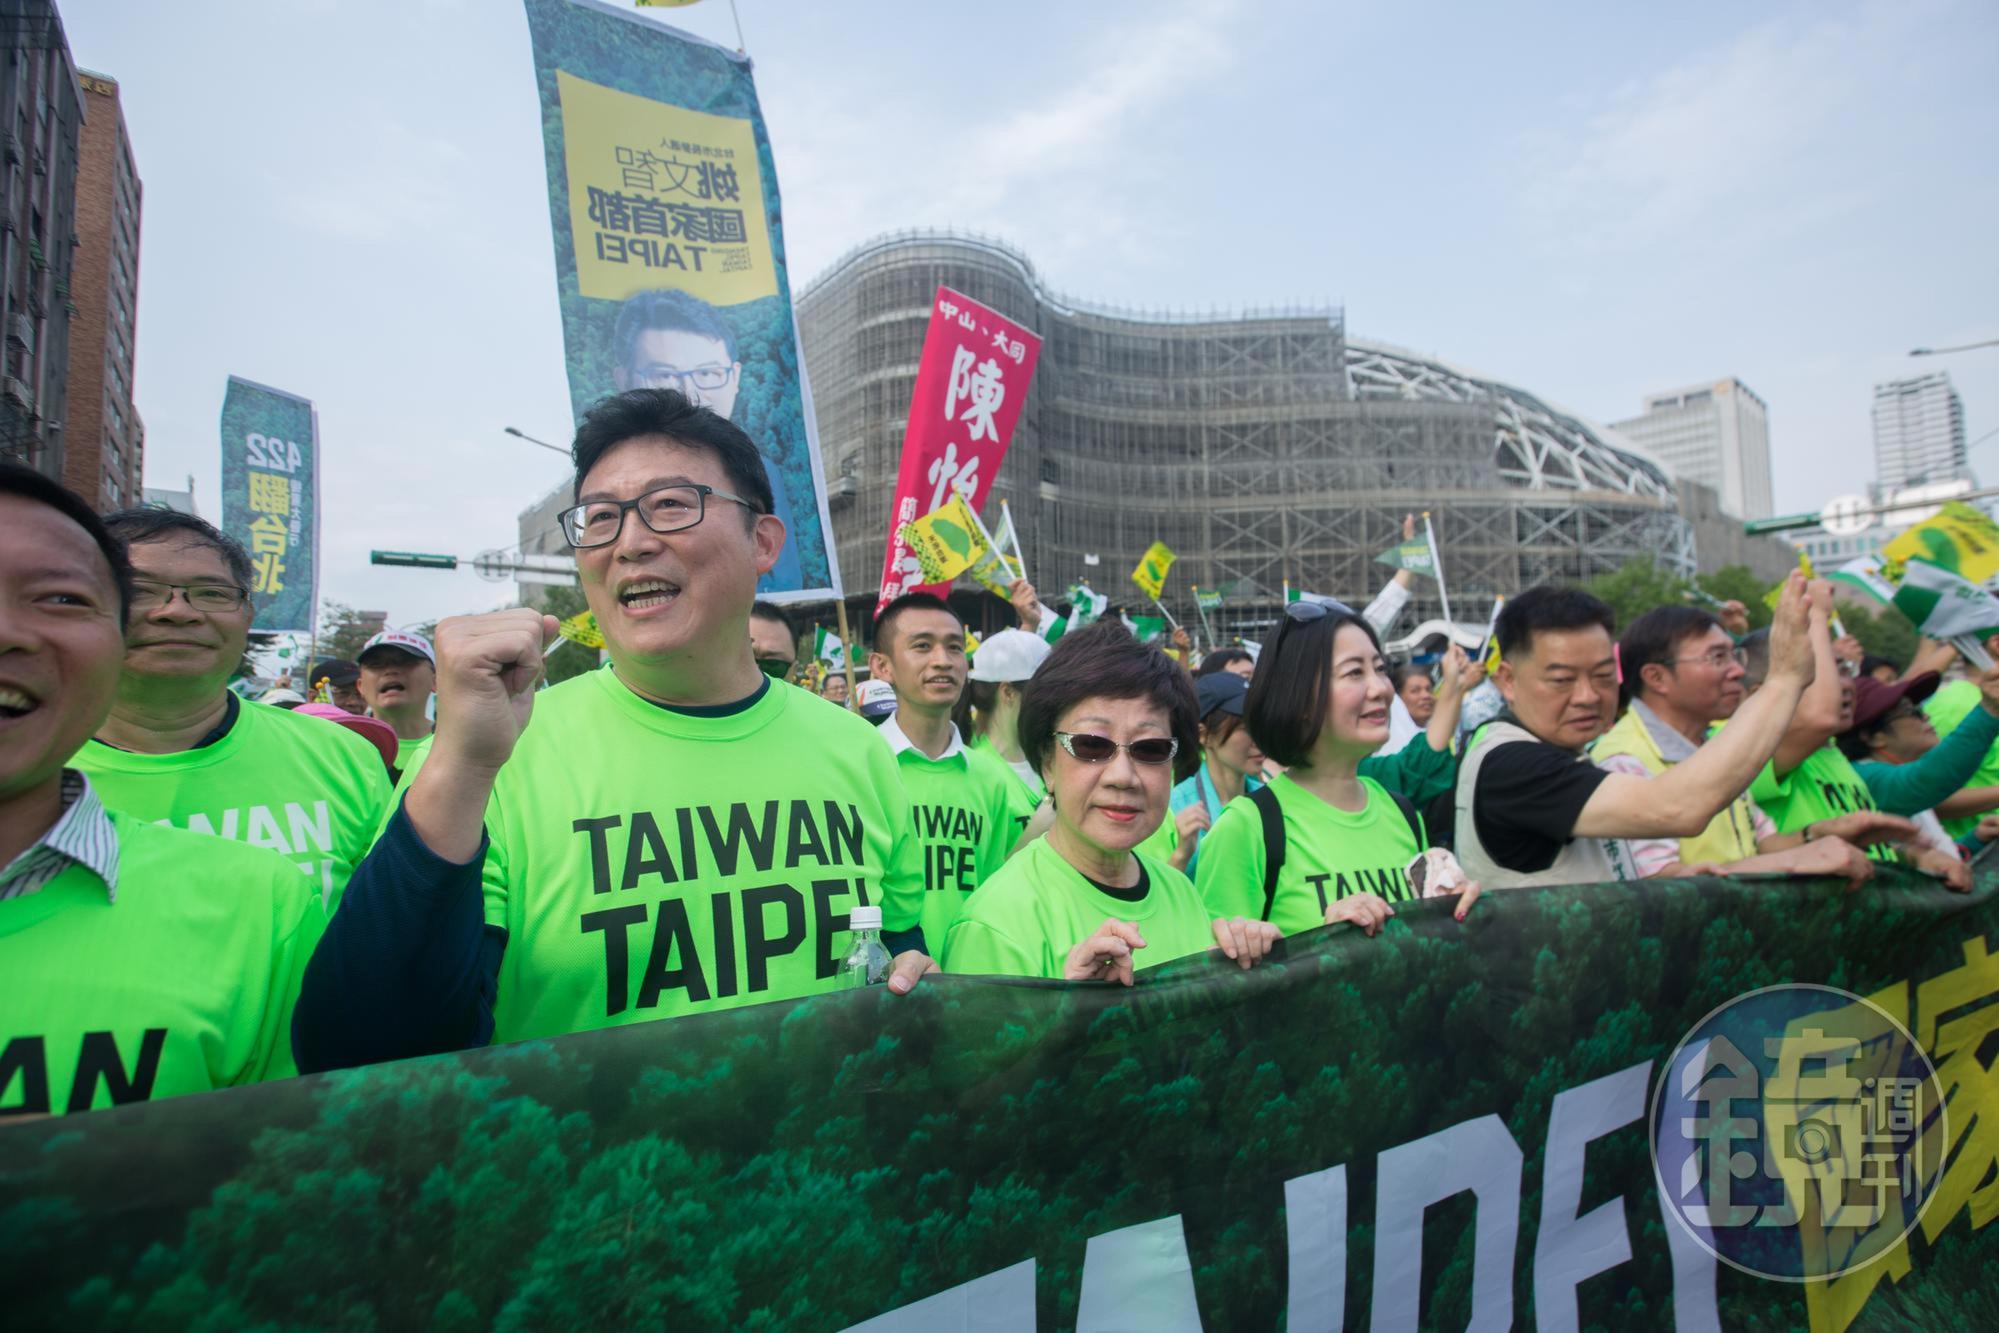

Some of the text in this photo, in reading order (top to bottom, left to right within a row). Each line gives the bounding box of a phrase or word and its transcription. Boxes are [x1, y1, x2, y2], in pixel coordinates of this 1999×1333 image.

[901, 344, 1005, 600] 陳怡
[572, 799, 865, 895] TAIWAN
[1304, 867, 1414, 918] TAIW
